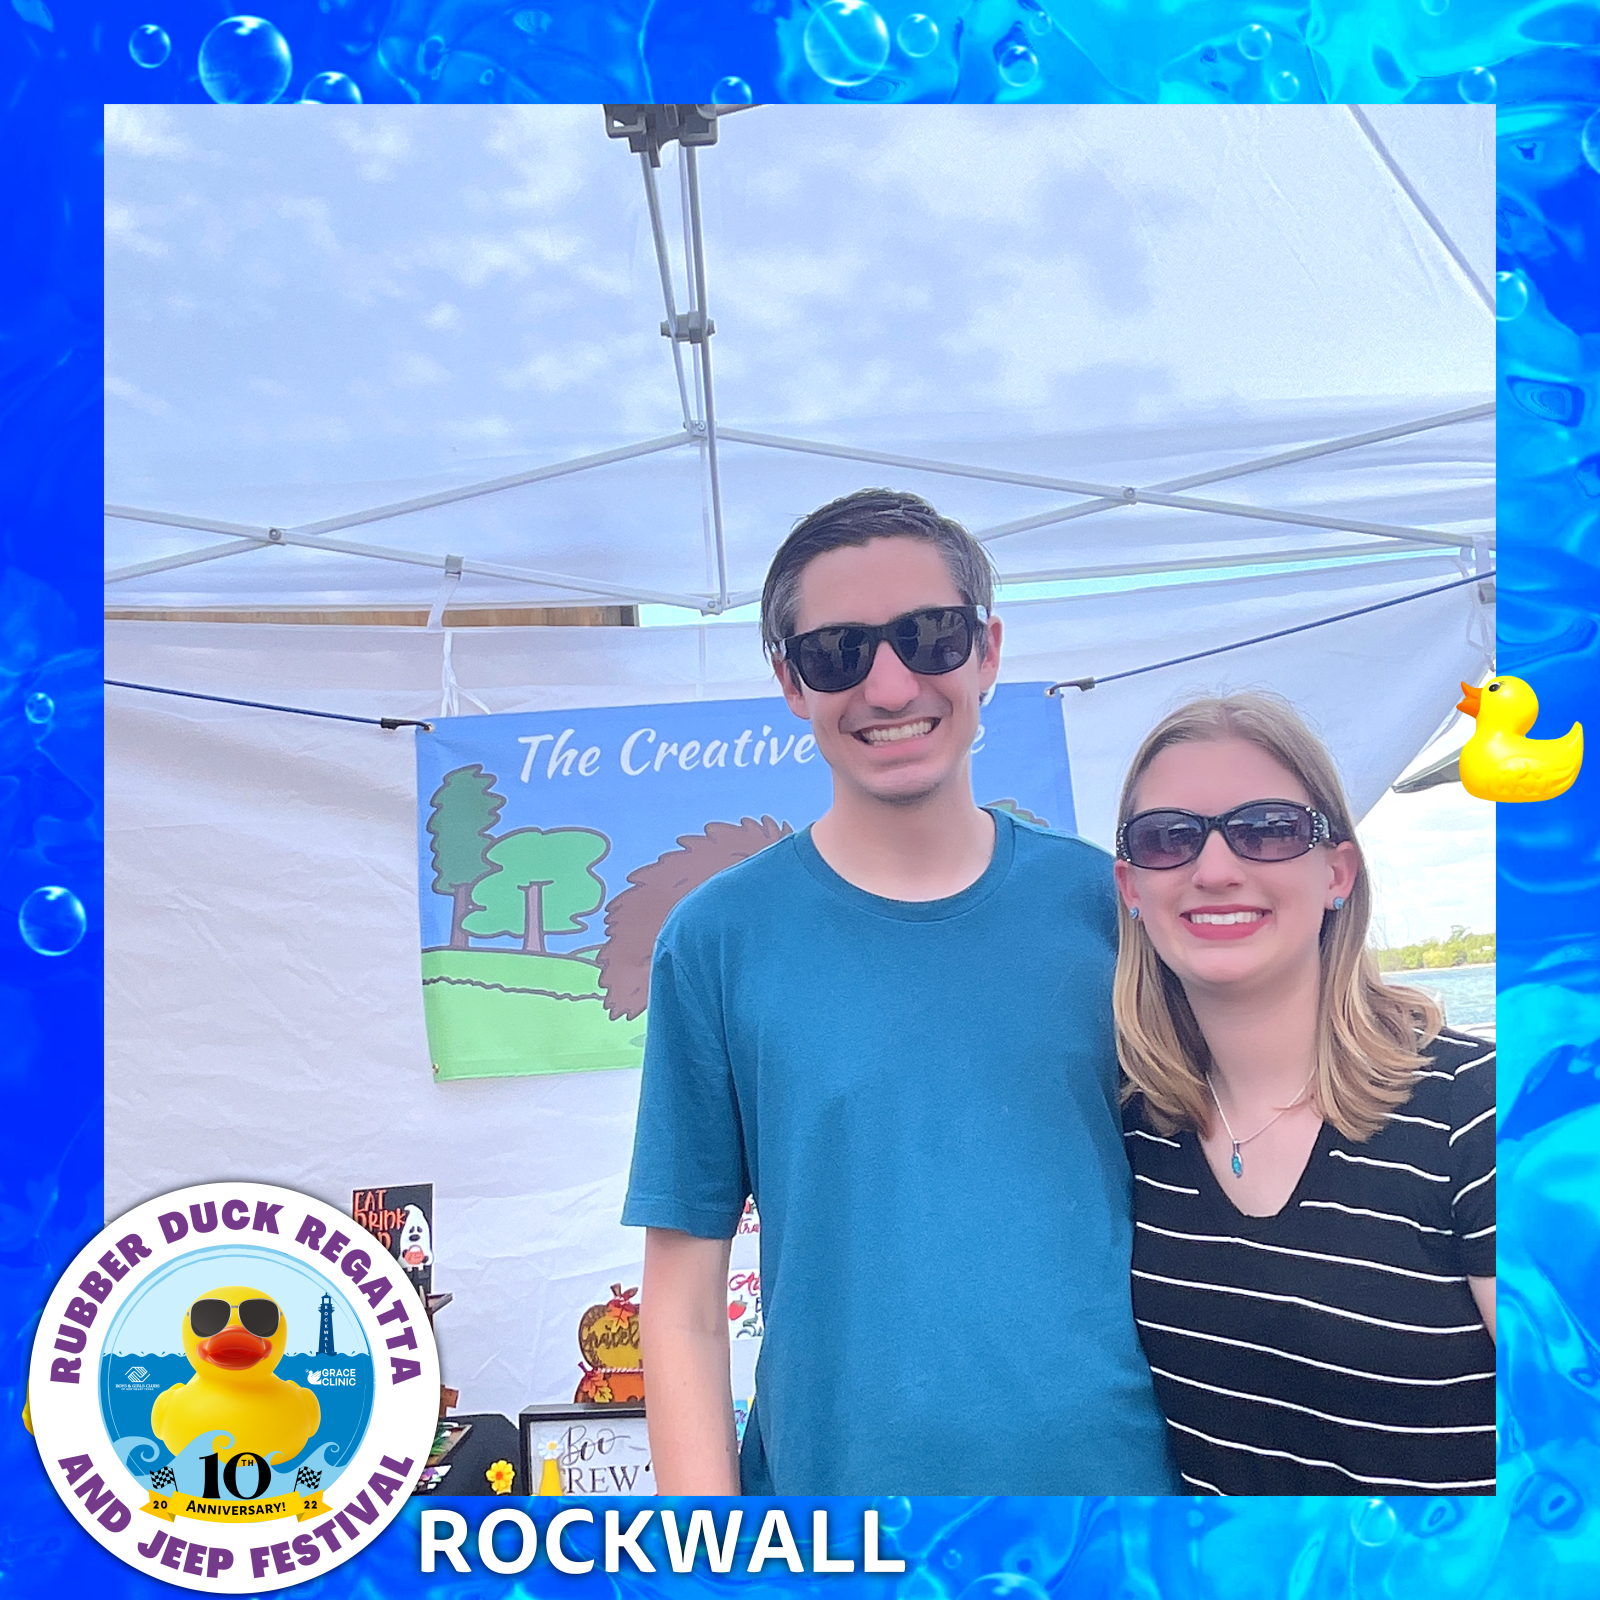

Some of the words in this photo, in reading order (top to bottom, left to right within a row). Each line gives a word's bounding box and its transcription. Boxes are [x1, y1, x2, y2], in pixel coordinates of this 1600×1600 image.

[517, 727, 601, 784] The
[619, 724, 816, 776] Creative
[354, 1189, 387, 1212] EAT
